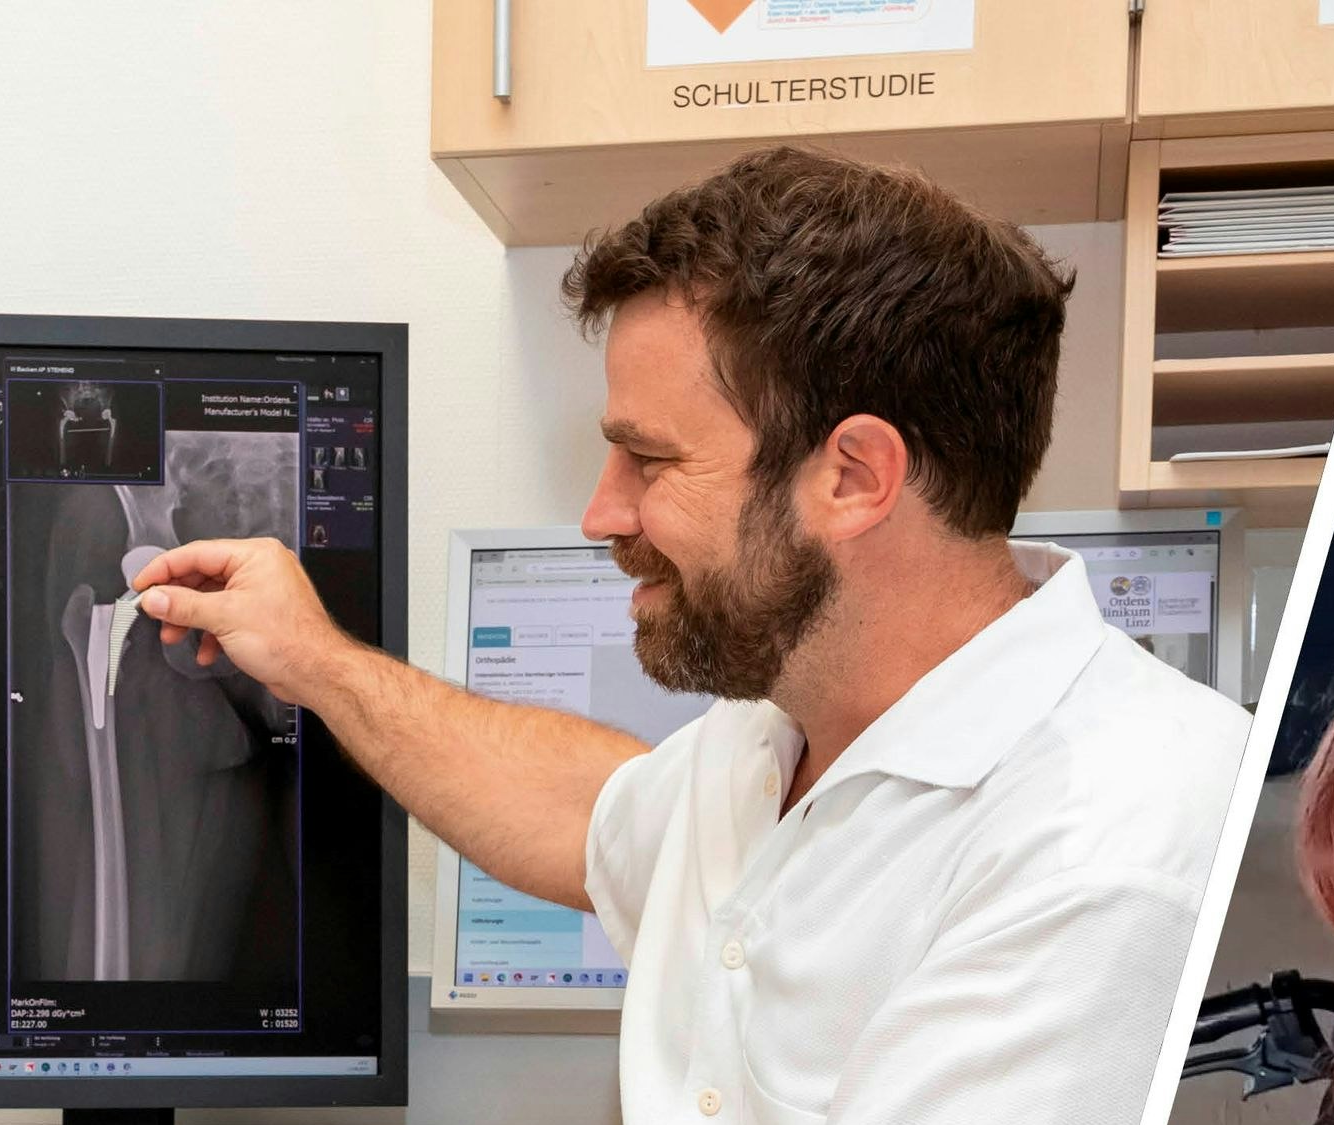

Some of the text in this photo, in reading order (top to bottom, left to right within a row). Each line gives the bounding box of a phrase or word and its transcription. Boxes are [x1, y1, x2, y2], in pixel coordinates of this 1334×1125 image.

[673, 72, 935, 108] SCHULTERSTUDIE
[201, 394, 239, 403] Institution
[204, 407, 259, 416] Manufacturer's
[260, 408, 282, 416] Model
[1109, 597, 1151, 607] Ordens
[1126, 618, 1151, 628] Linz
[259, 1008, 269, 1017] W
[262, 1019, 269, 1028] C
